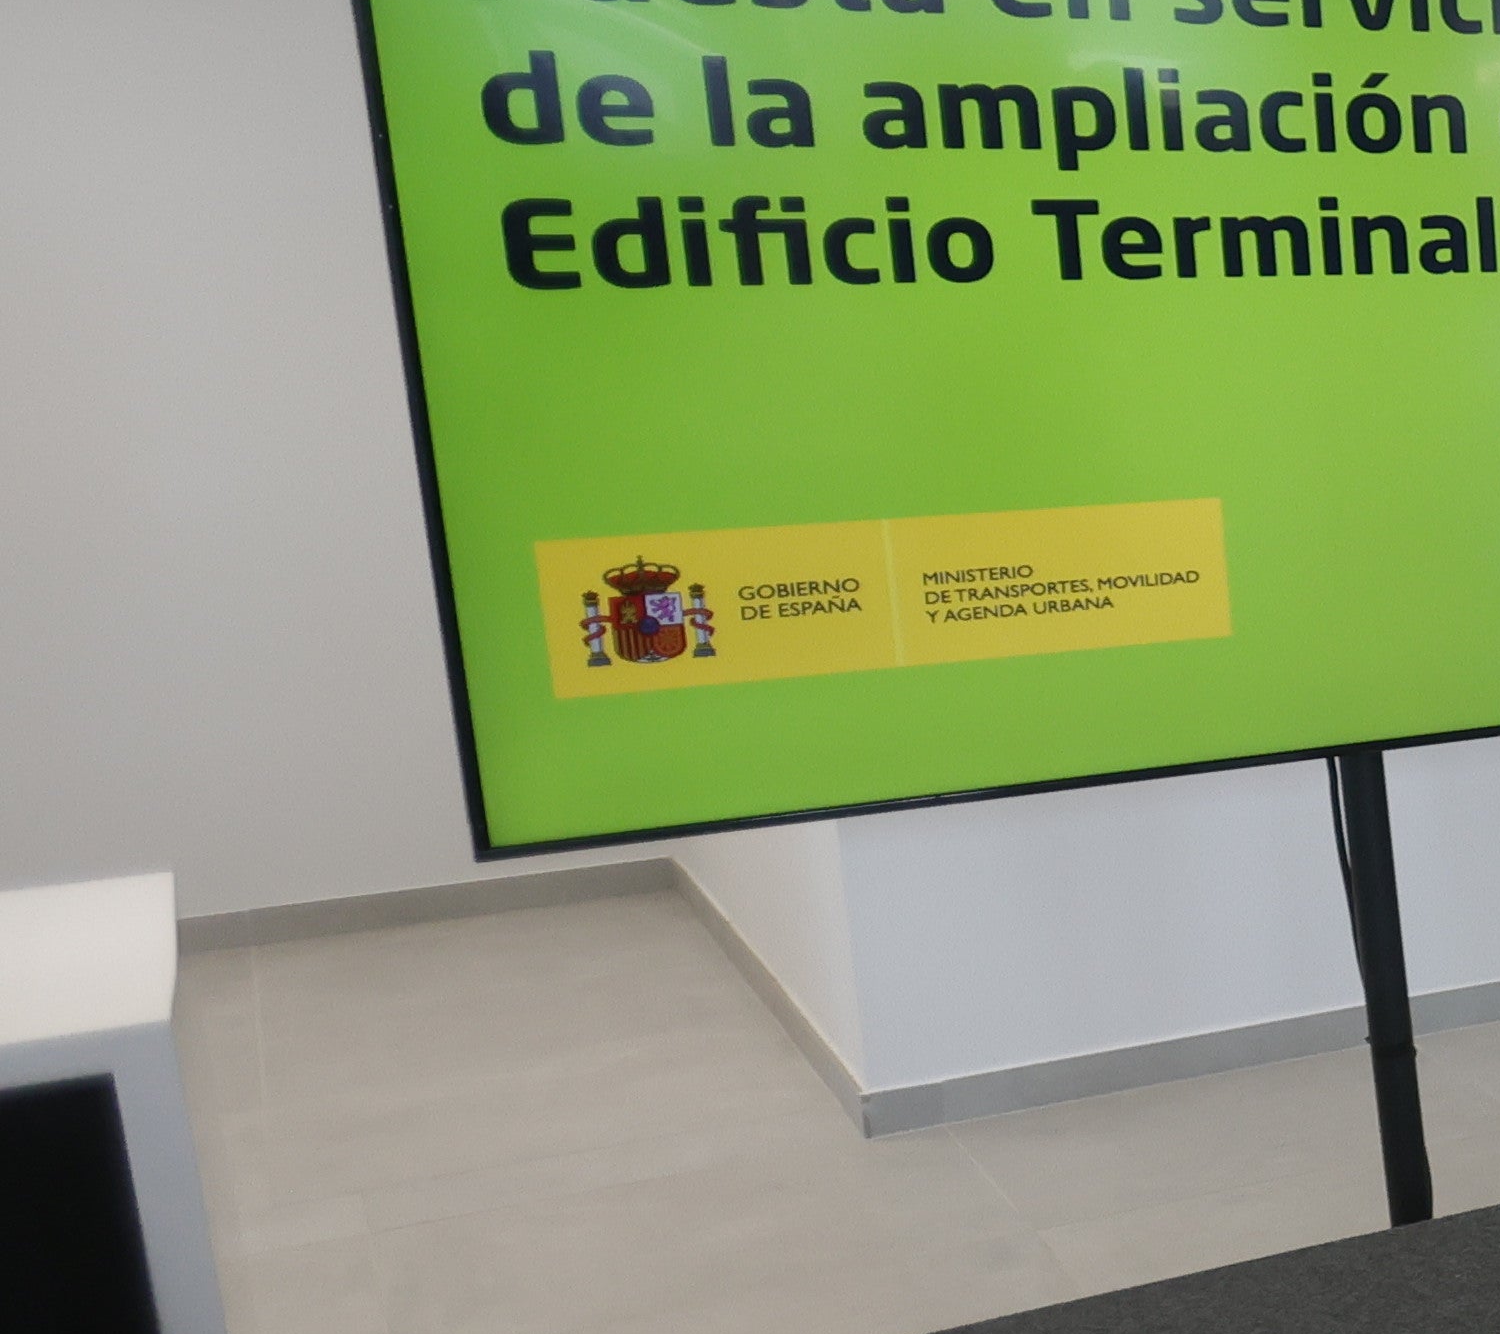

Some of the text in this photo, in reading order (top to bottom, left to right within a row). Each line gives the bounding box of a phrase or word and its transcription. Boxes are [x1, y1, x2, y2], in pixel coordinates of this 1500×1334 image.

[481, 51, 654, 146] de
[703, 56, 815, 148] la
[863, 68, 1467, 171] ampliación
[501, 196, 994, 290] Edificio
[738, 578, 859, 600] GOBIERNO
[923, 565, 1034, 586] MINISTERIO
[925, 571, 1199, 604] DE TRANSPORTES, MOVILIDAD
[741, 592, 862, 620] DE ESPAÑA
[926, 593, 1113, 623] Y AGENDA URBANA
